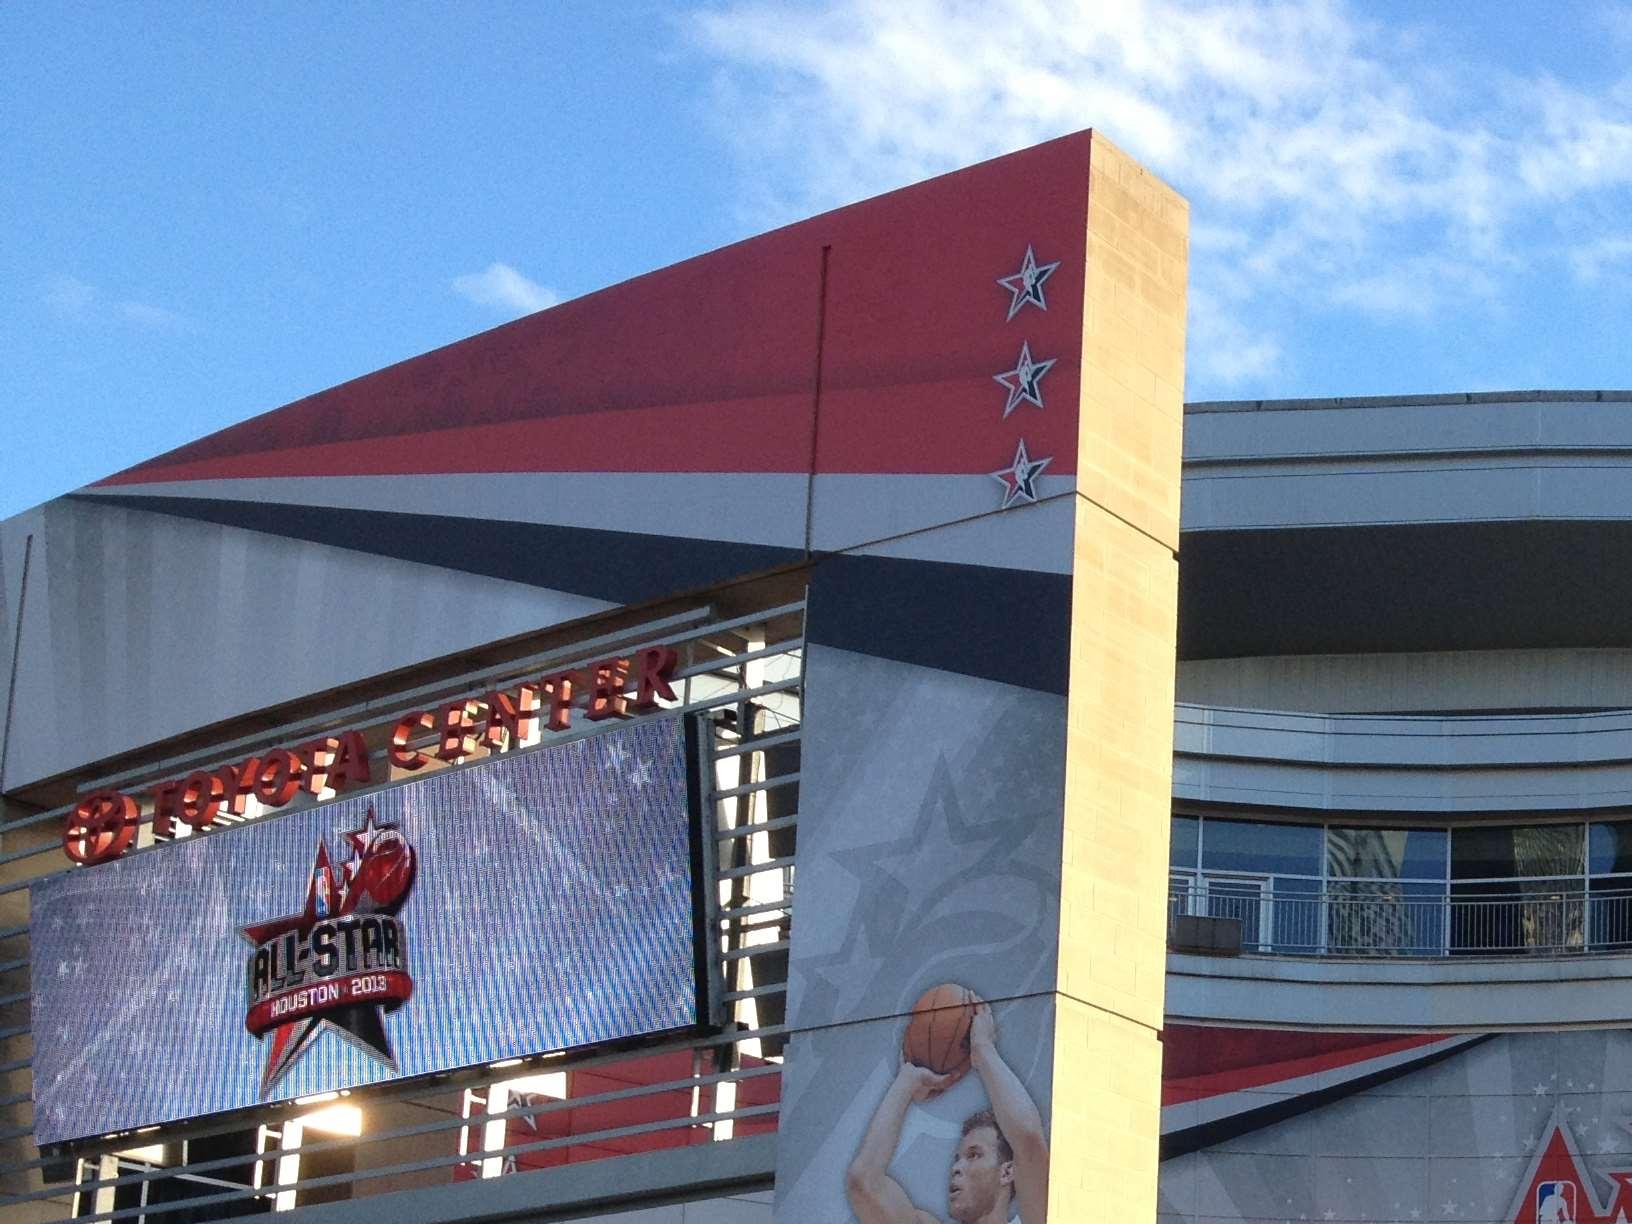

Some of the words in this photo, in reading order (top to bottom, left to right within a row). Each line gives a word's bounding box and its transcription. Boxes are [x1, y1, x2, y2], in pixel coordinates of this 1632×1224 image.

[150, 730, 370, 842] TOYOTA
[389, 645, 678, 770] CENTER
[252, 917, 401, 1000] ALL-STAR
[271, 984, 338, 1018] HOUSTON
[352, 975, 387, 995] 2013
